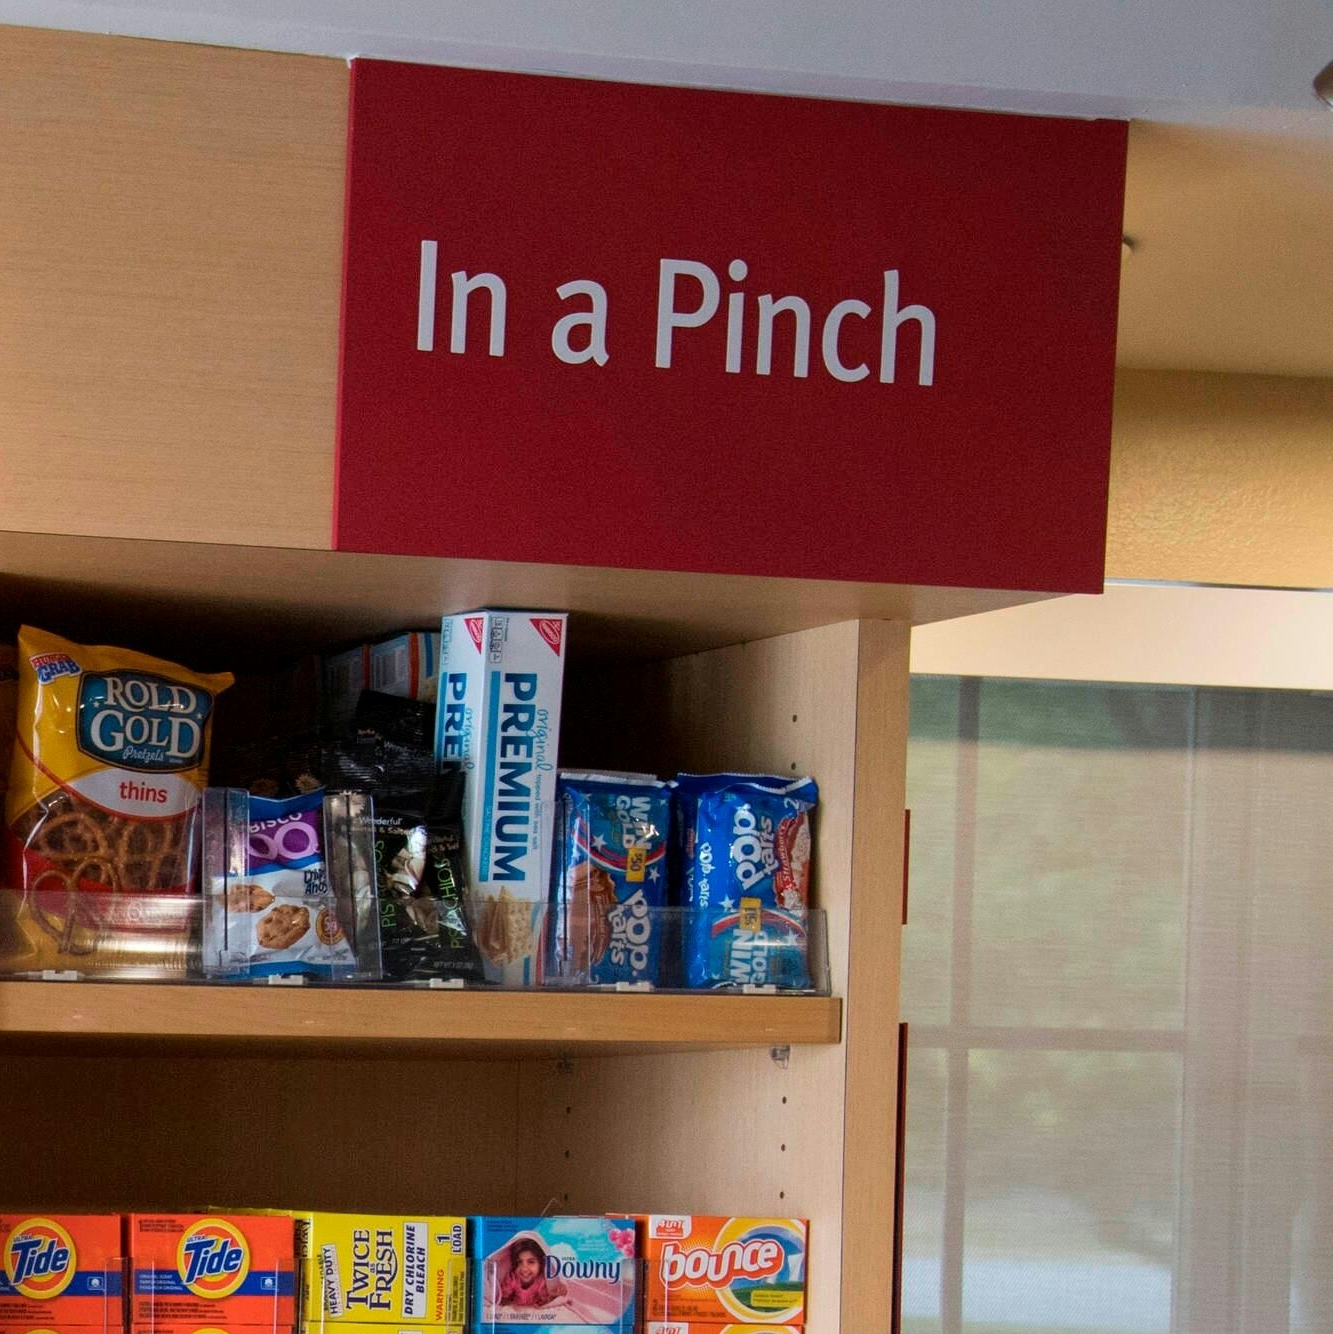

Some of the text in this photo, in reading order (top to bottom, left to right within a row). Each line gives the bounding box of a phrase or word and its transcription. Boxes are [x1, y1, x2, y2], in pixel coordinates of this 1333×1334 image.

[417, 240, 935, 386] In a Pinch
[102, 676, 198, 715] ROLD
[90, 709, 202, 758] GOLD
[119, 780, 167, 804] thins
[492, 672, 538, 882] PREMIUM
[10, 1237, 70, 1285] Tide
[184, 1237, 244, 1285] Tide
[452, 1225, 463, 1254] LOAD
[663, 1242, 779, 1282] bounce
[345, 1229, 370, 1310] TWICE
[369, 1229, 398, 1310] FRESH
[404, 1224, 416, 1315] DRY CHLORINE
[414, 1247, 426, 1294] BLEACH
[545, 1254, 621, 1284] Downy
[435, 1269, 445, 1322] WARNING
